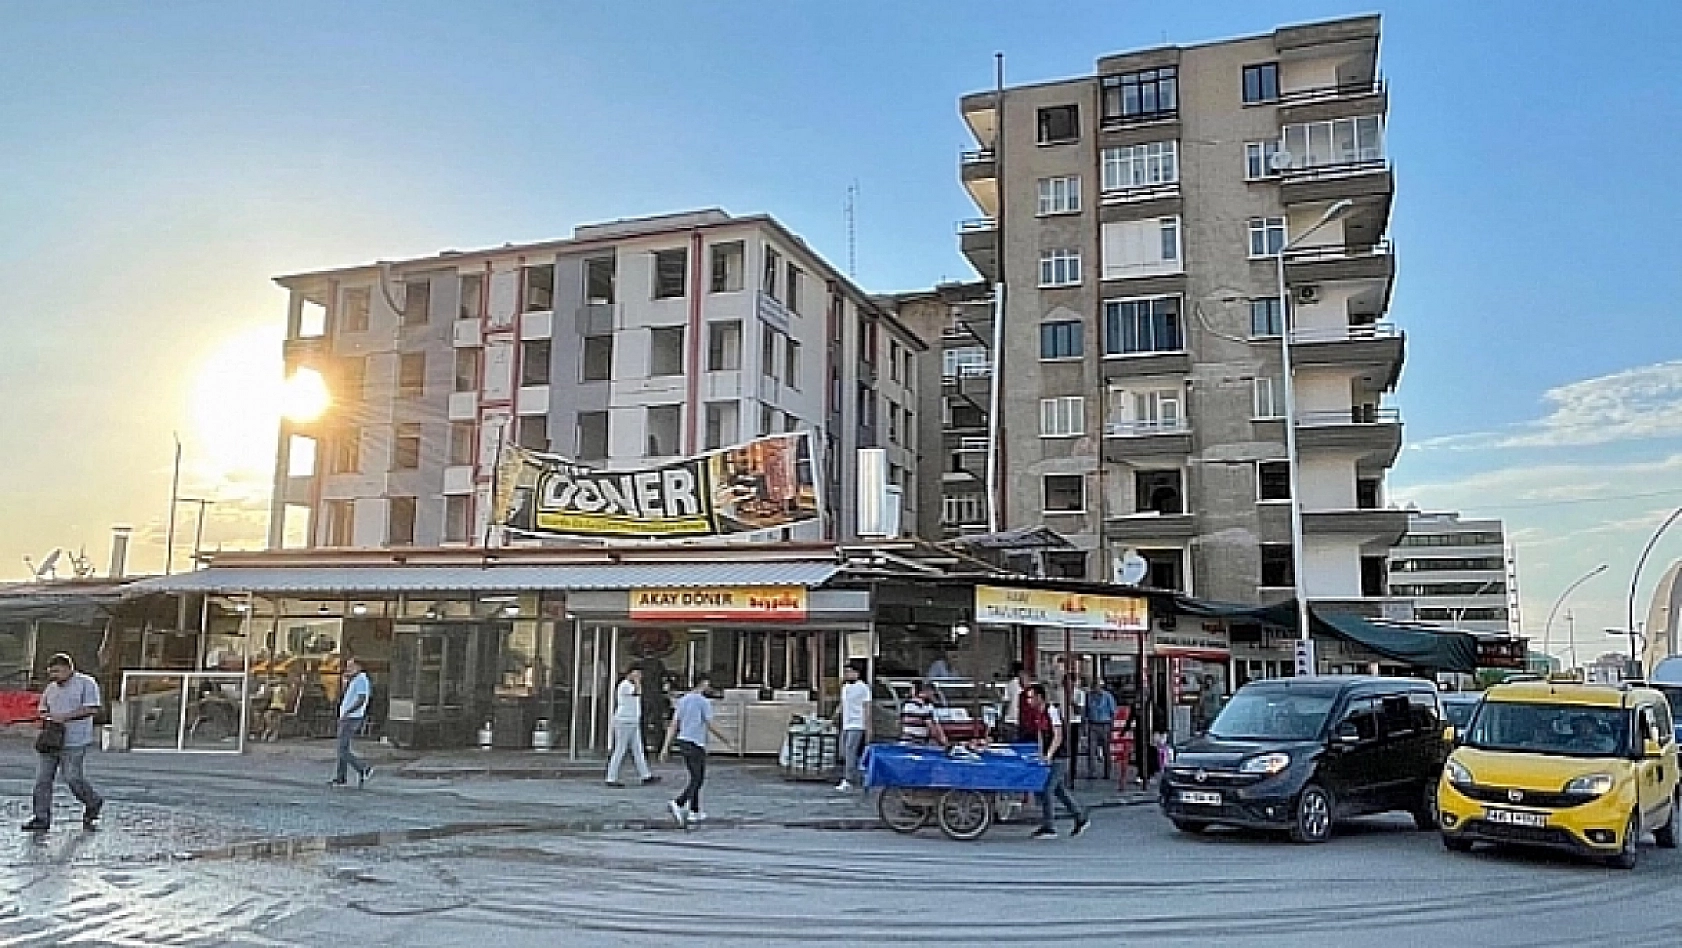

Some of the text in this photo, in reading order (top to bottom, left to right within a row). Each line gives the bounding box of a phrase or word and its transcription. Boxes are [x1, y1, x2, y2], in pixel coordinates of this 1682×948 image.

[543, 465, 699, 518] DÖNER
[639, 590, 732, 606] AKAY DÖNER
